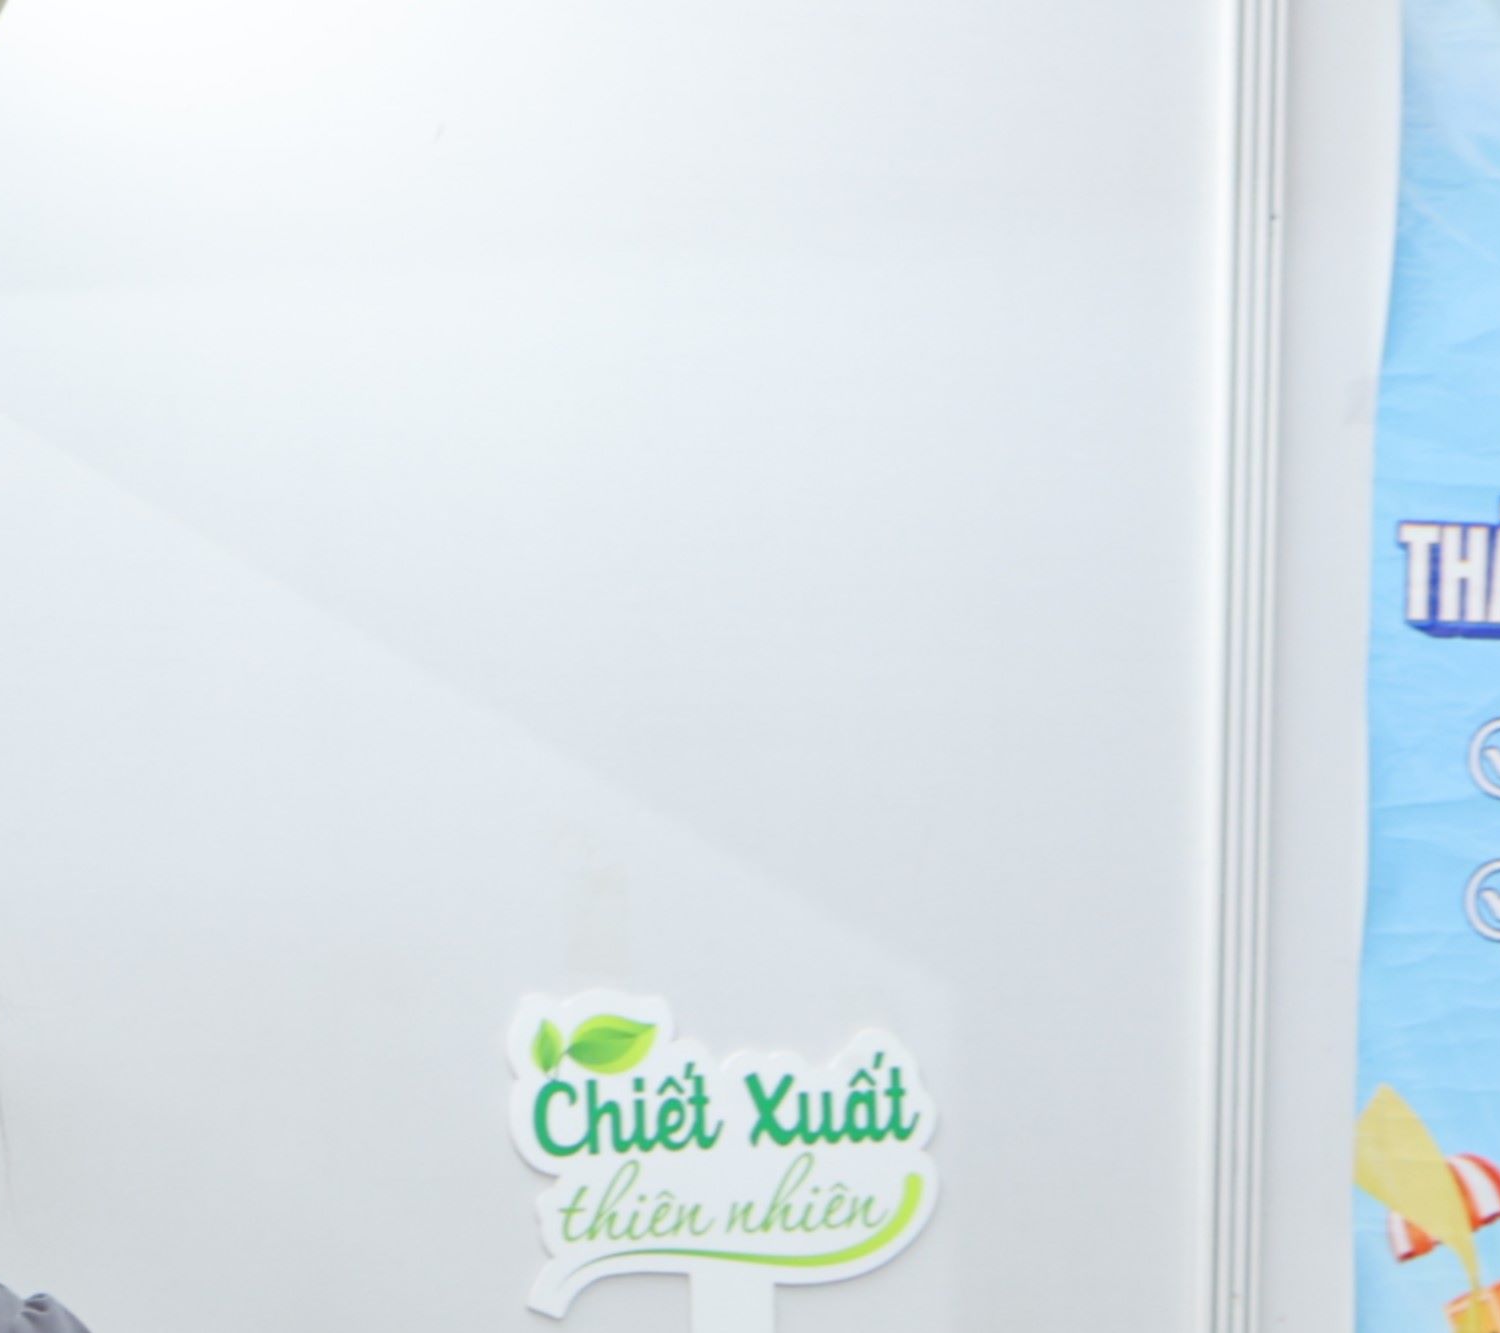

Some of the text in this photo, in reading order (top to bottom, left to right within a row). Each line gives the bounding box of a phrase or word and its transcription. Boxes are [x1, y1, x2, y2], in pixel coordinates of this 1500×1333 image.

[532, 1050, 920, 1157] Chiết Xuất
[556, 1152, 891, 1243] thiên nhiên
